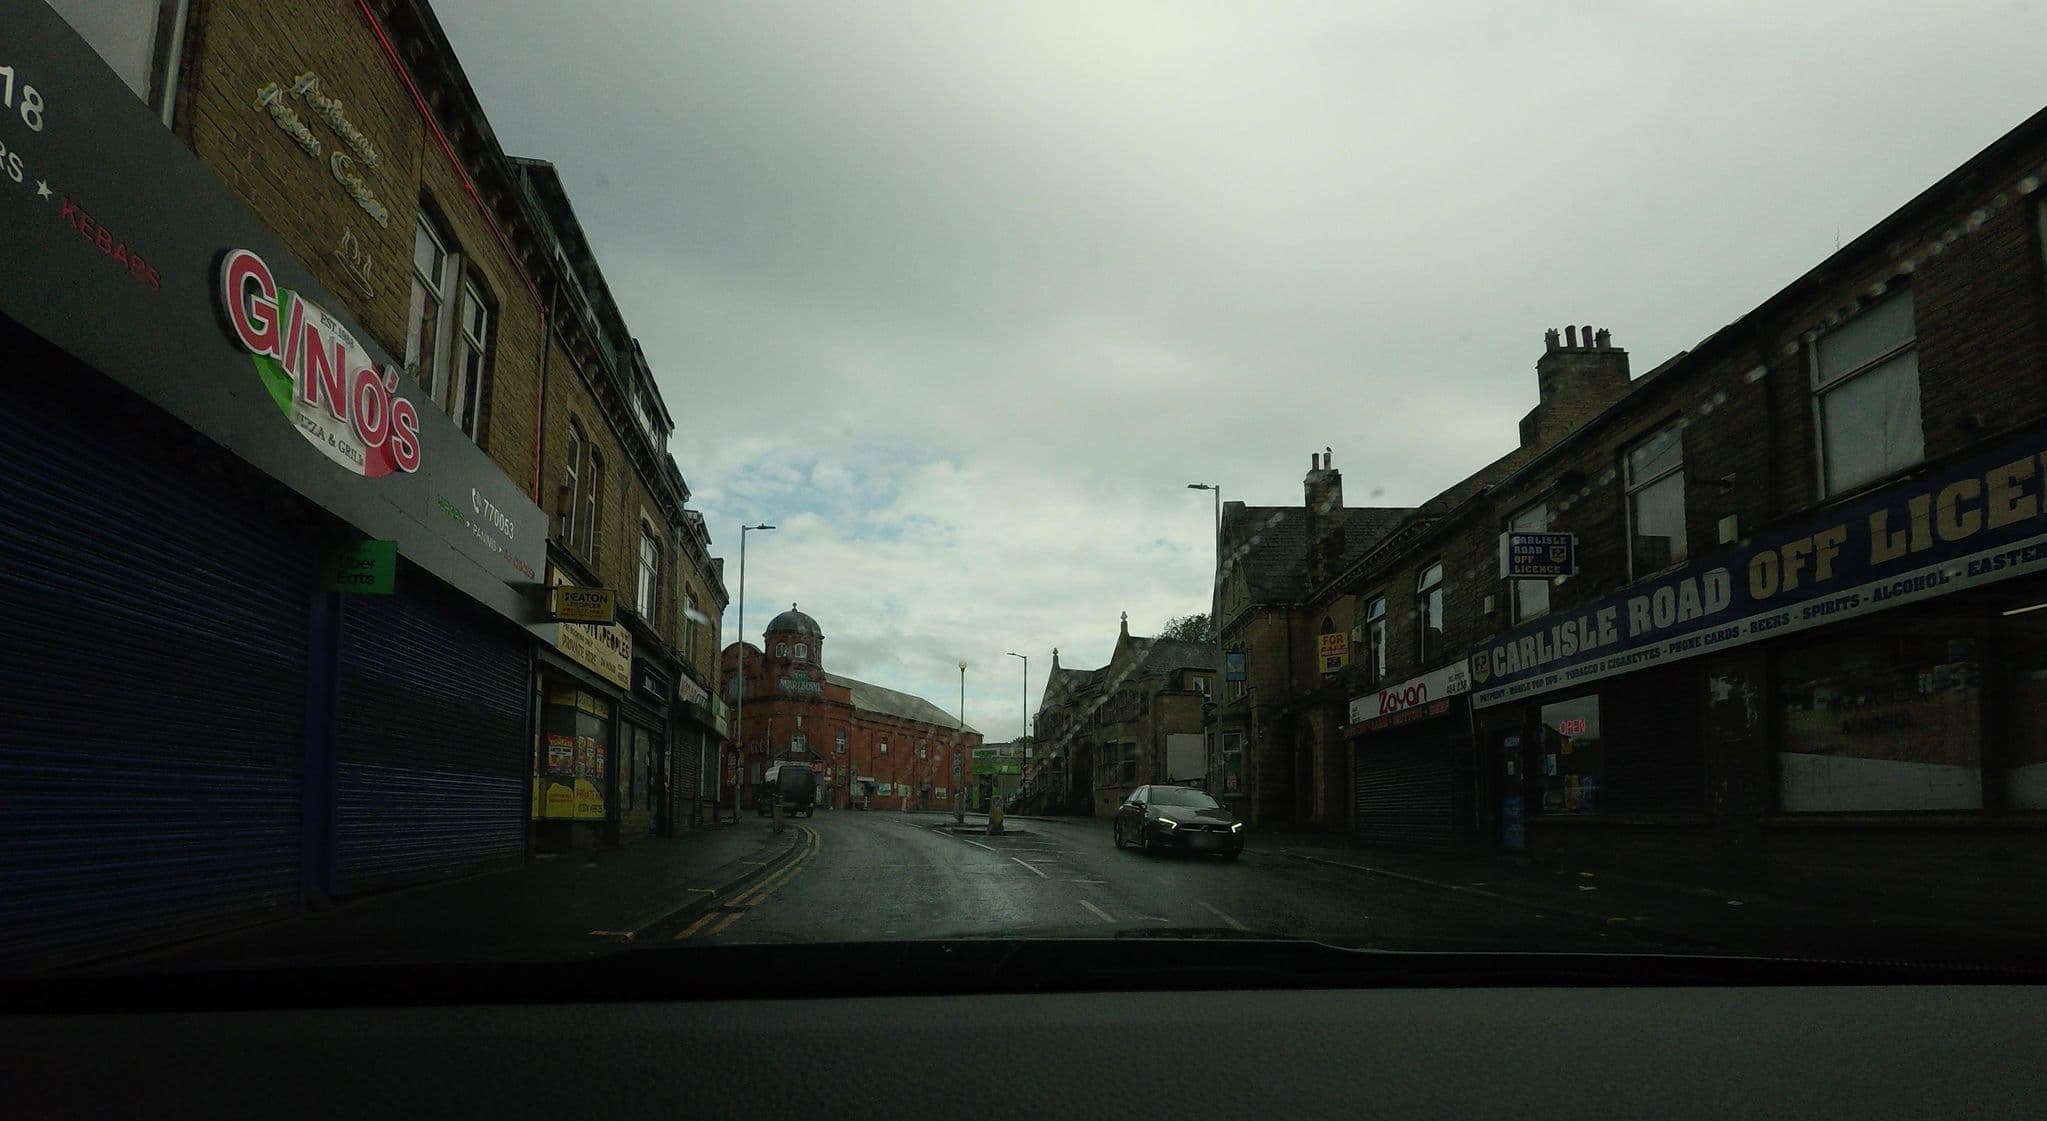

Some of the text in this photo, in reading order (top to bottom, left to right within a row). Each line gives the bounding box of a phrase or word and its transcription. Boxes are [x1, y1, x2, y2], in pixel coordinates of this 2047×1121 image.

[59, 195, 160, 291] KEBABS
[220, 247, 420, 474] GINO'S
[484, 499, 514, 540] 770053
[1512, 535, 1567, 545] CARLISLE
[1513, 545, 1543, 554] ROAD
[1491, 604, 1619, 680] CARLISLE
[1627, 566, 1732, 638] ROAD
[1749, 523, 1848, 600] OFF
[1868, 448, 2047, 567] LICE
[1513, 555, 1534, 563] OFF
[1514, 565, 1560, 573] LICENCE
[1566, 662, 1599, 682] TOBACCO
[1608, 645, 1661, 673] CIGARETTES
[1669, 634, 1705, 656] PHONE
[1705, 625, 1740, 647] CARDS
[1750, 611, 1790, 635] BEERS
[1802, 593, 1861, 622] SPIRITS
[1873, 563, 1951, 603] ALCOHOL
[1323, 634, 1344, 645] FOR
[1379, 682, 1427, 715] Zayan
[1560, 719, 1585, 736] OPEN
